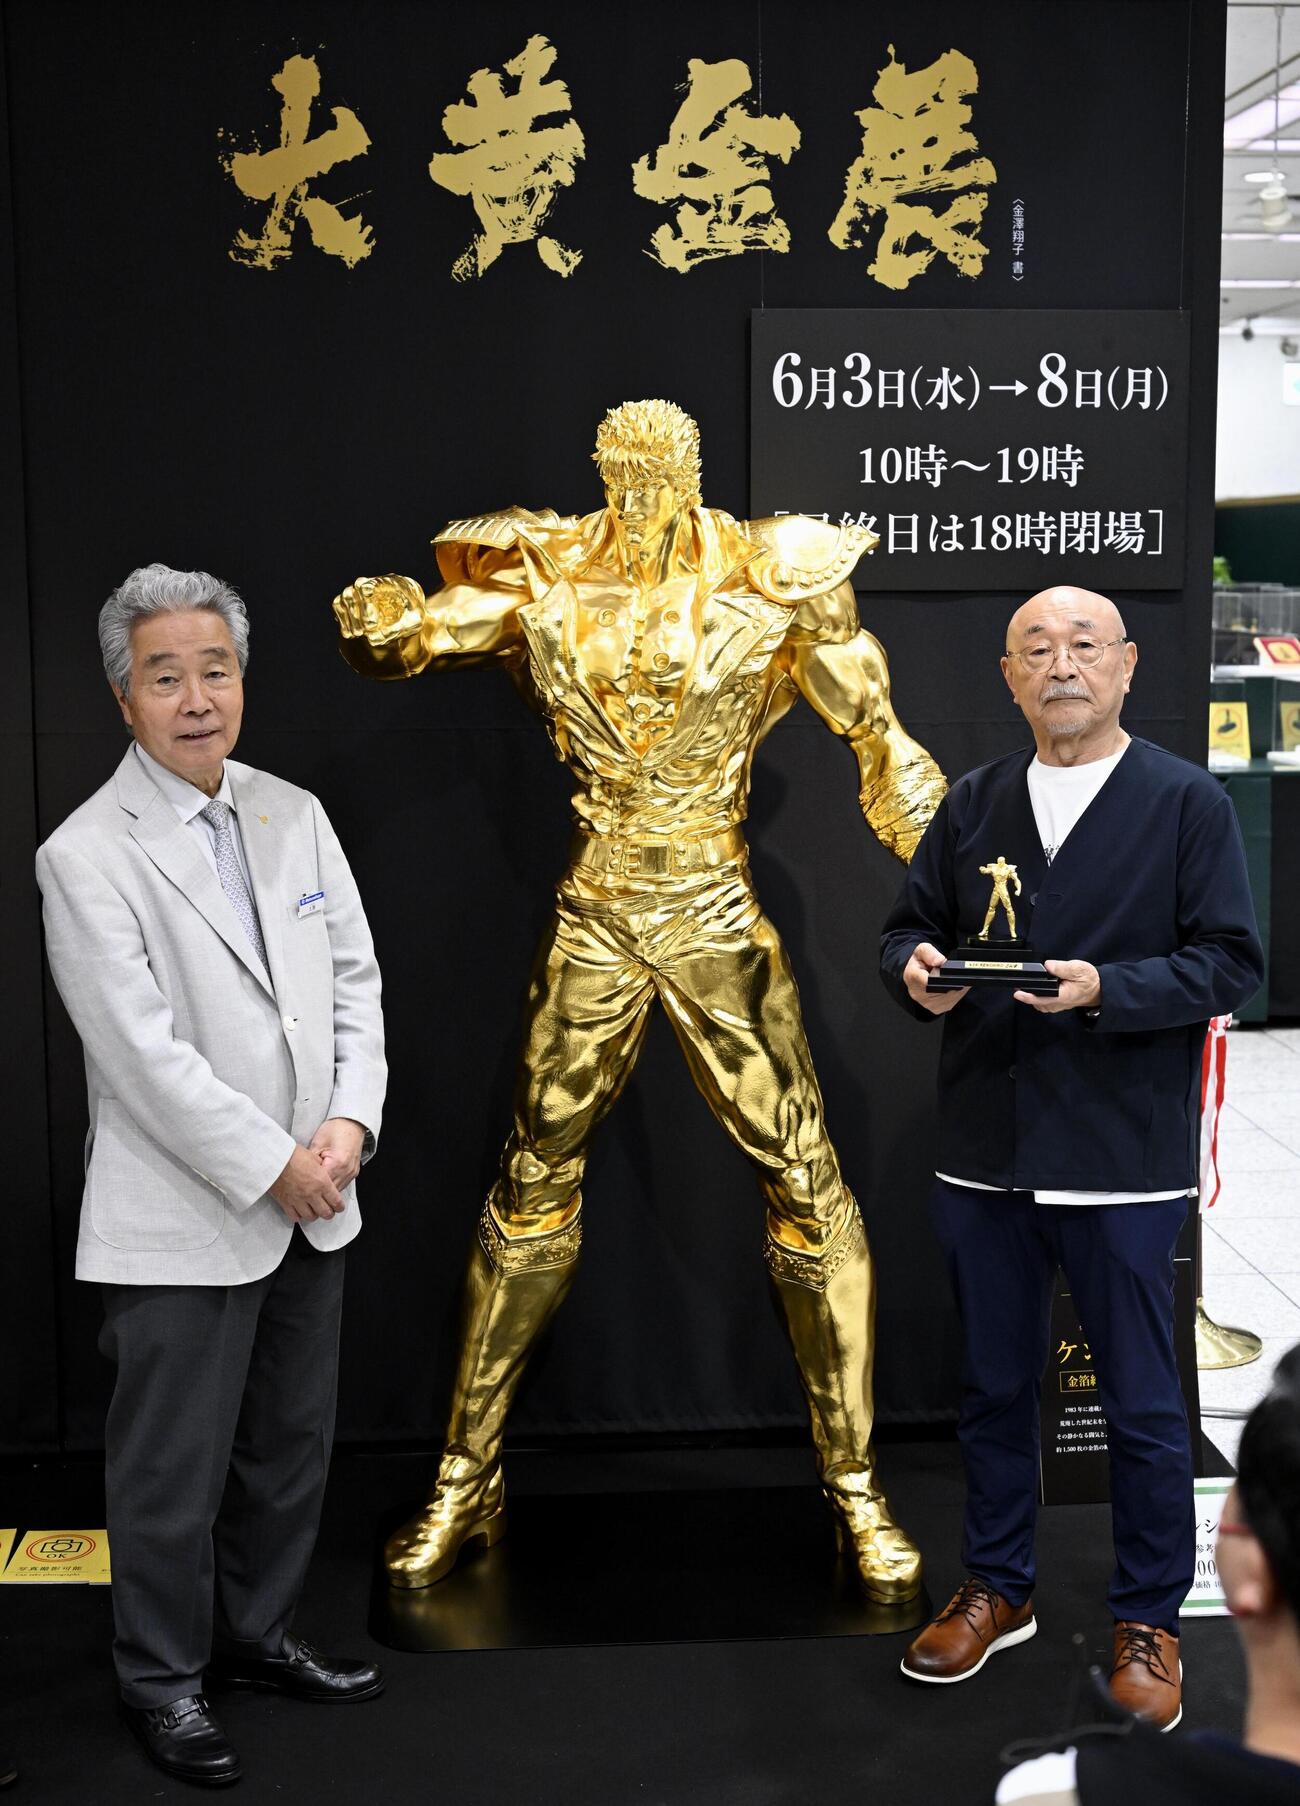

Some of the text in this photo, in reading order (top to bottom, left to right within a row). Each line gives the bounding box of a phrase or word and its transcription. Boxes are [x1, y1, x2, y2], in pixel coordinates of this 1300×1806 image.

[216, 33, 997, 291] 大黄金展
[858, 444, 1085, 488] 10時〜19時
[774, 510, 1164, 556] 日は18時閉場]
